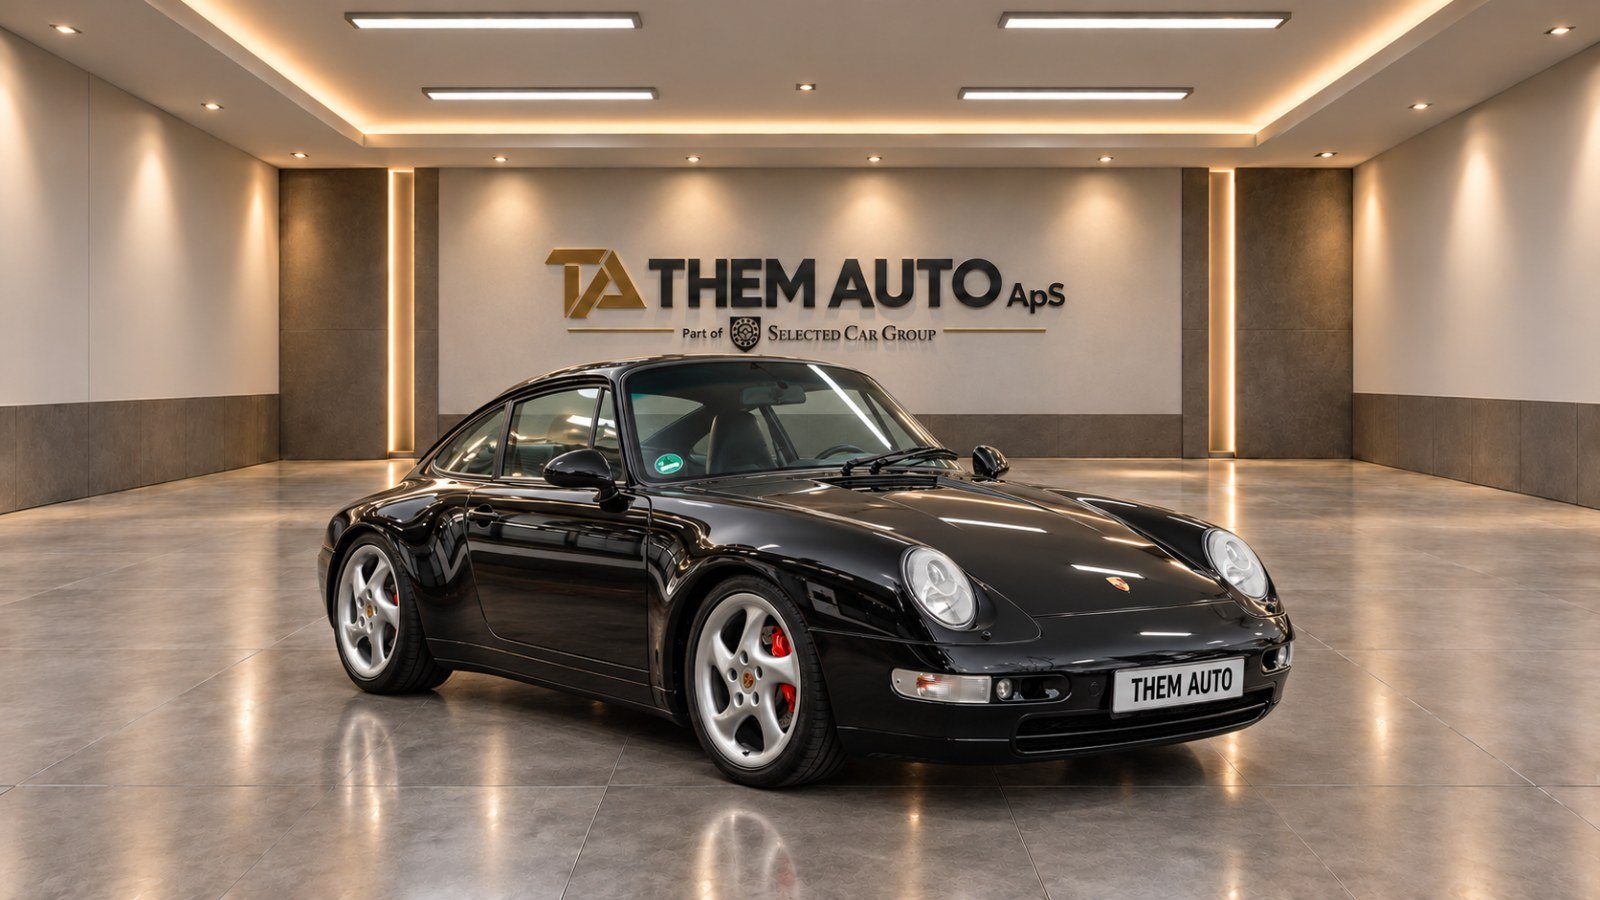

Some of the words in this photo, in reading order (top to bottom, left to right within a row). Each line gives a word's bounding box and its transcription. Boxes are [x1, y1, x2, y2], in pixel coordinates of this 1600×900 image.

[648, 258, 816, 309] THEM
[828, 258, 1003, 309] AUTO
[1007, 282, 1066, 314] ApS
[682, 328, 706, 340] Part
[710, 328, 723, 340] of
[768, 325, 840, 342] SELECTED
[844, 325, 878, 342] CAR
[882, 325, 937, 342] GROUP
[1131, 674, 1182, 702] THEM
[1187, 667, 1233, 696] AUTO
